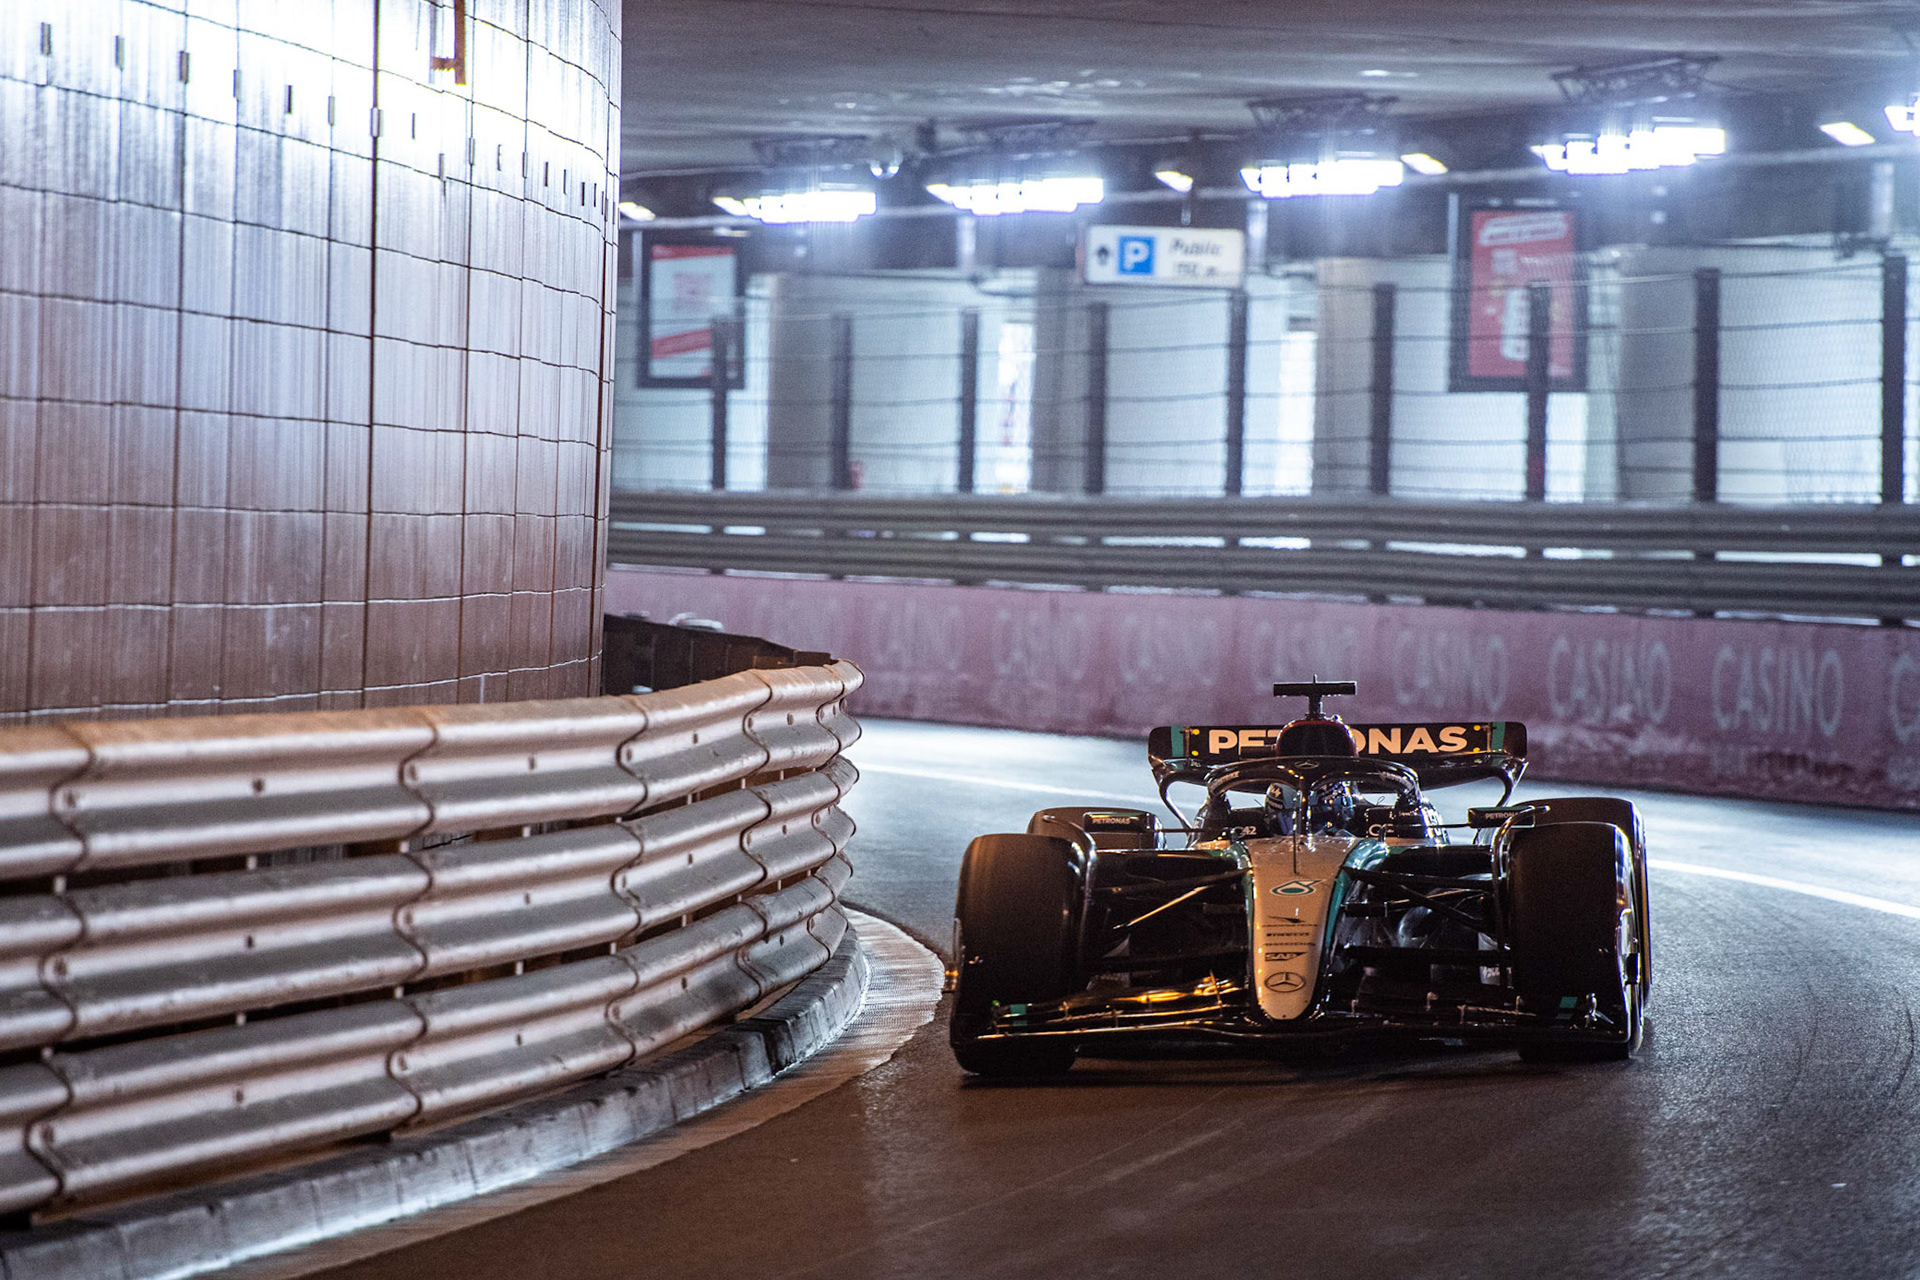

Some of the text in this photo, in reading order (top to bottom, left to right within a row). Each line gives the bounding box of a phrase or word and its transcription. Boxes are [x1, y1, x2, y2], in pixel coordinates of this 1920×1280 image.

[1123, 241, 1150, 270] P
[1711, 645, 1844, 740] CASINO
[1209, 726, 1468, 754] PENAS
[1091, 816, 1131, 825] PETRONAS
